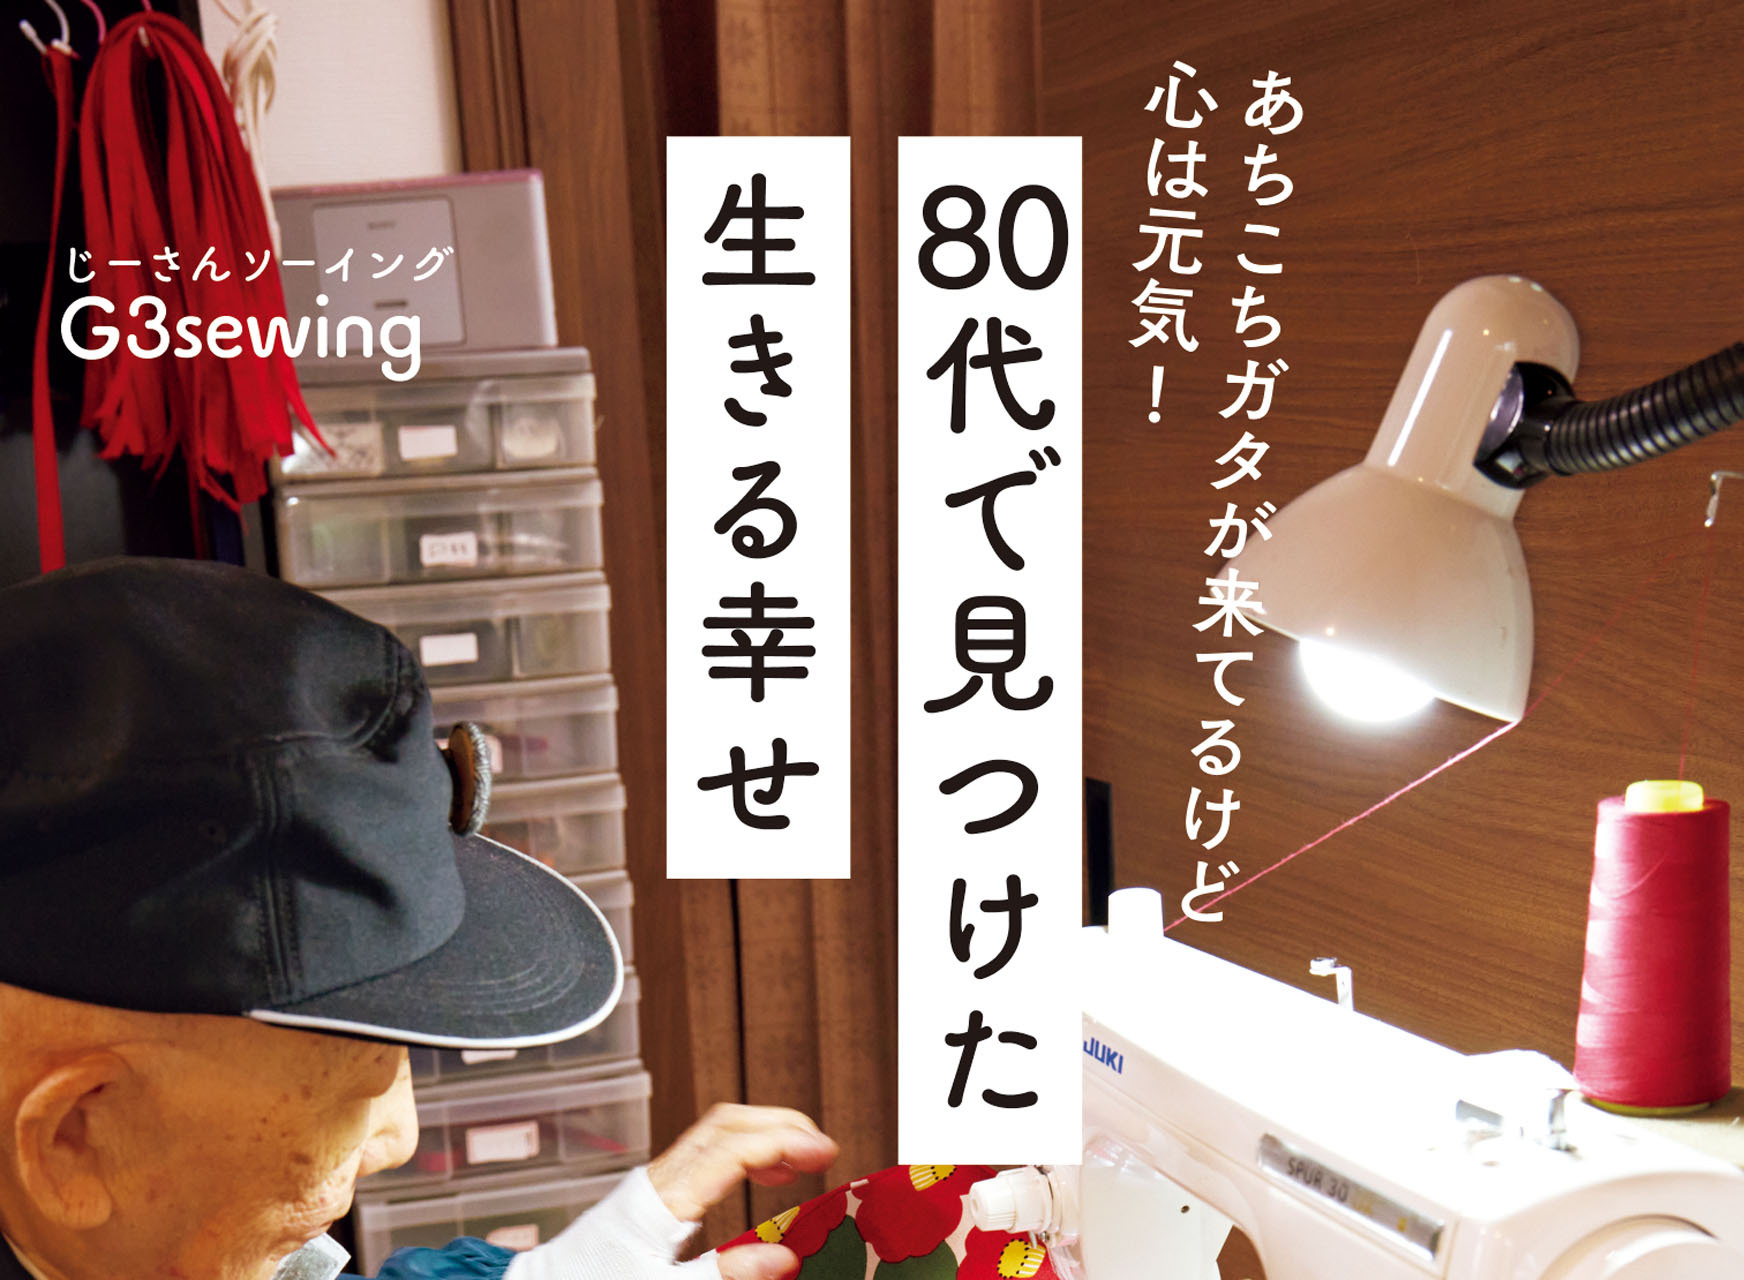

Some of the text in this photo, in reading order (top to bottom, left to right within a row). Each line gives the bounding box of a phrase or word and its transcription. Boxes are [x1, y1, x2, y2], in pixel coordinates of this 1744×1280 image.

[1082, 1037, 1123, 1074] JUKI
[1288, 1157, 1350, 1203] SPUR 30
